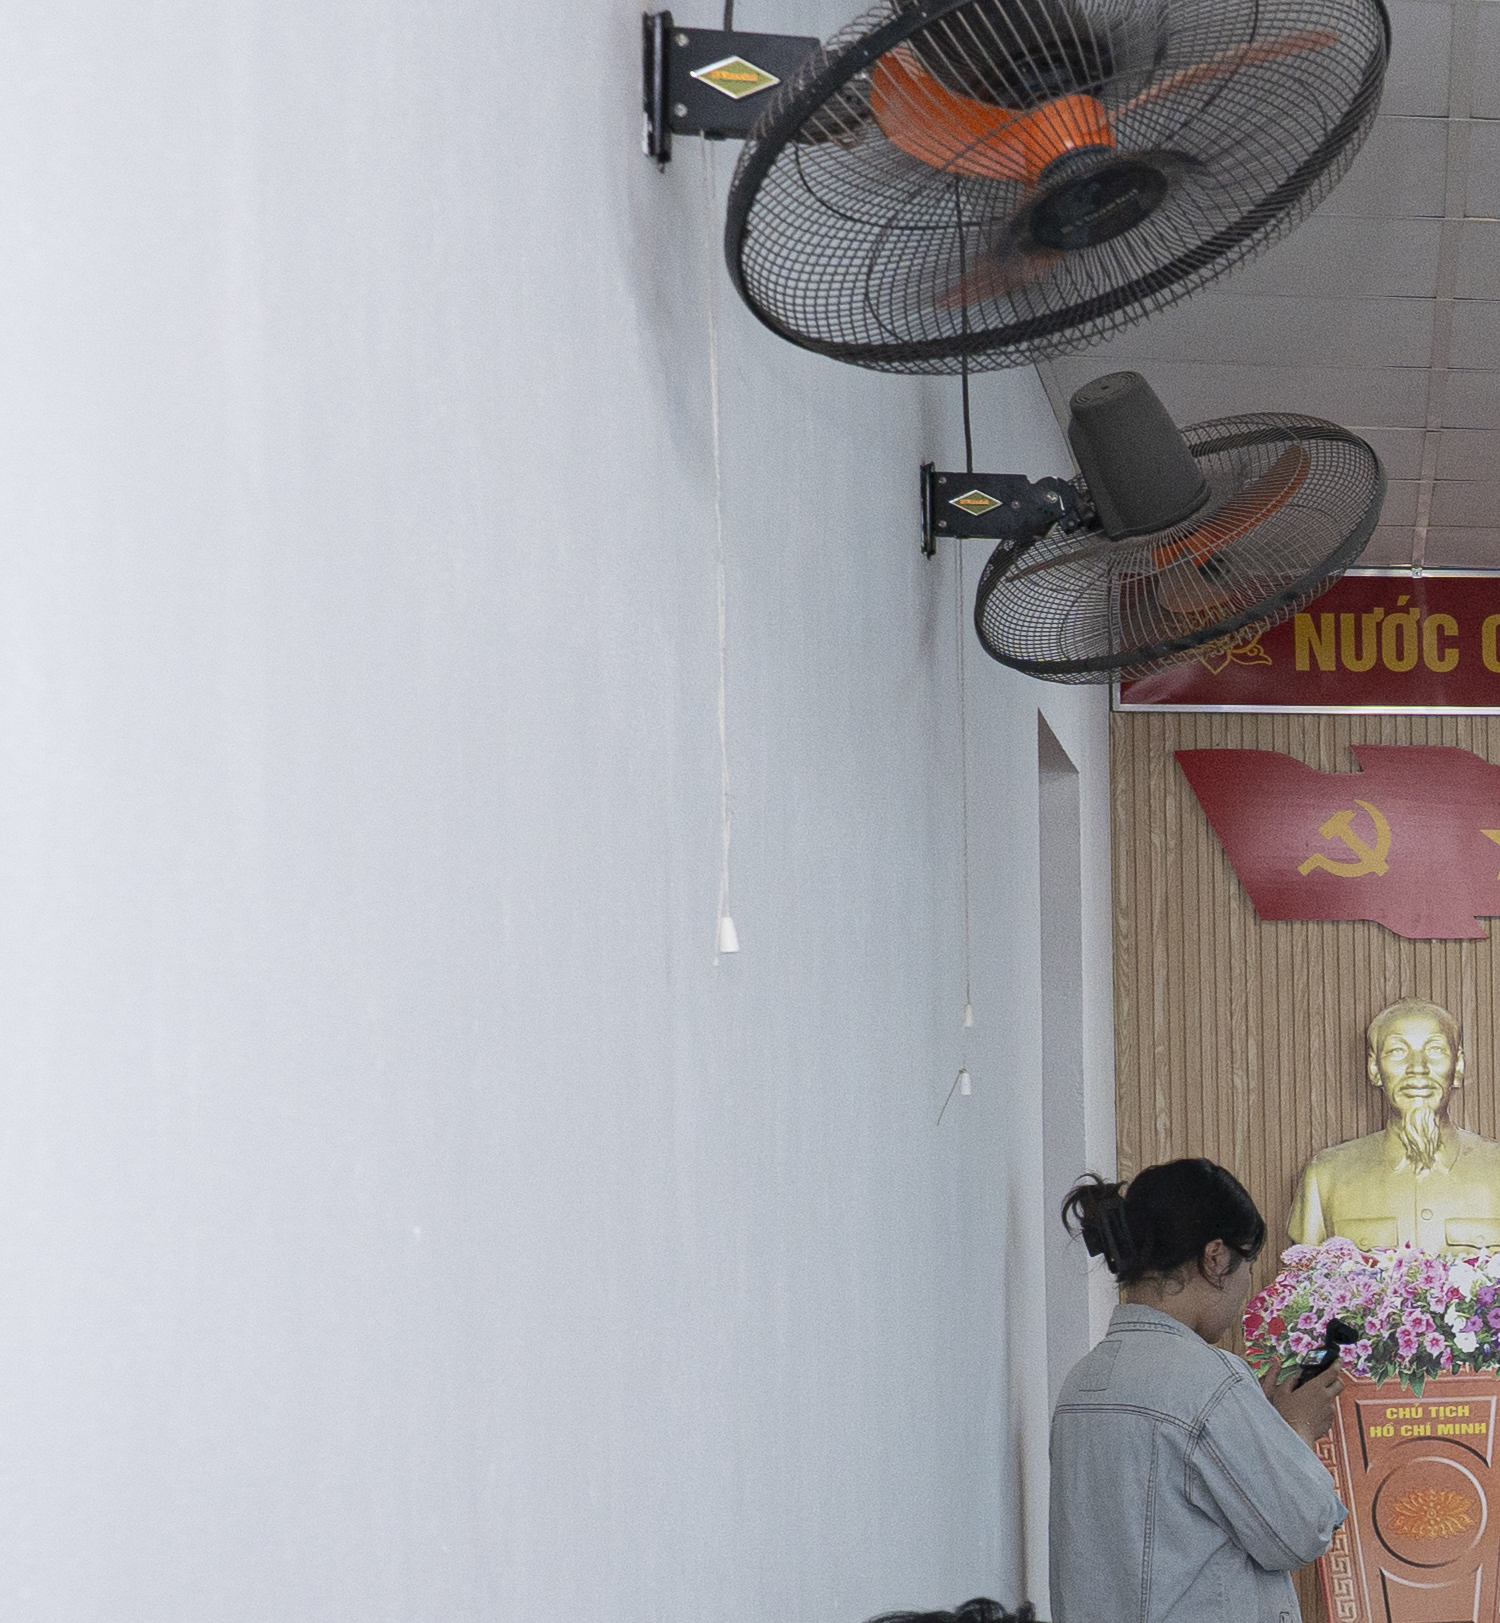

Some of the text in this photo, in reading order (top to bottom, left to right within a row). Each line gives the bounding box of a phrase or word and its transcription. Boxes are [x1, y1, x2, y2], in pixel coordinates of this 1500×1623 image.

[1294, 595, 1460, 673] NƯỚC
[1386, 1403, 1470, 1420] CHỦ TỊCH
[1369, 1421, 1487, 1438] HỒ CHÍ MINH
